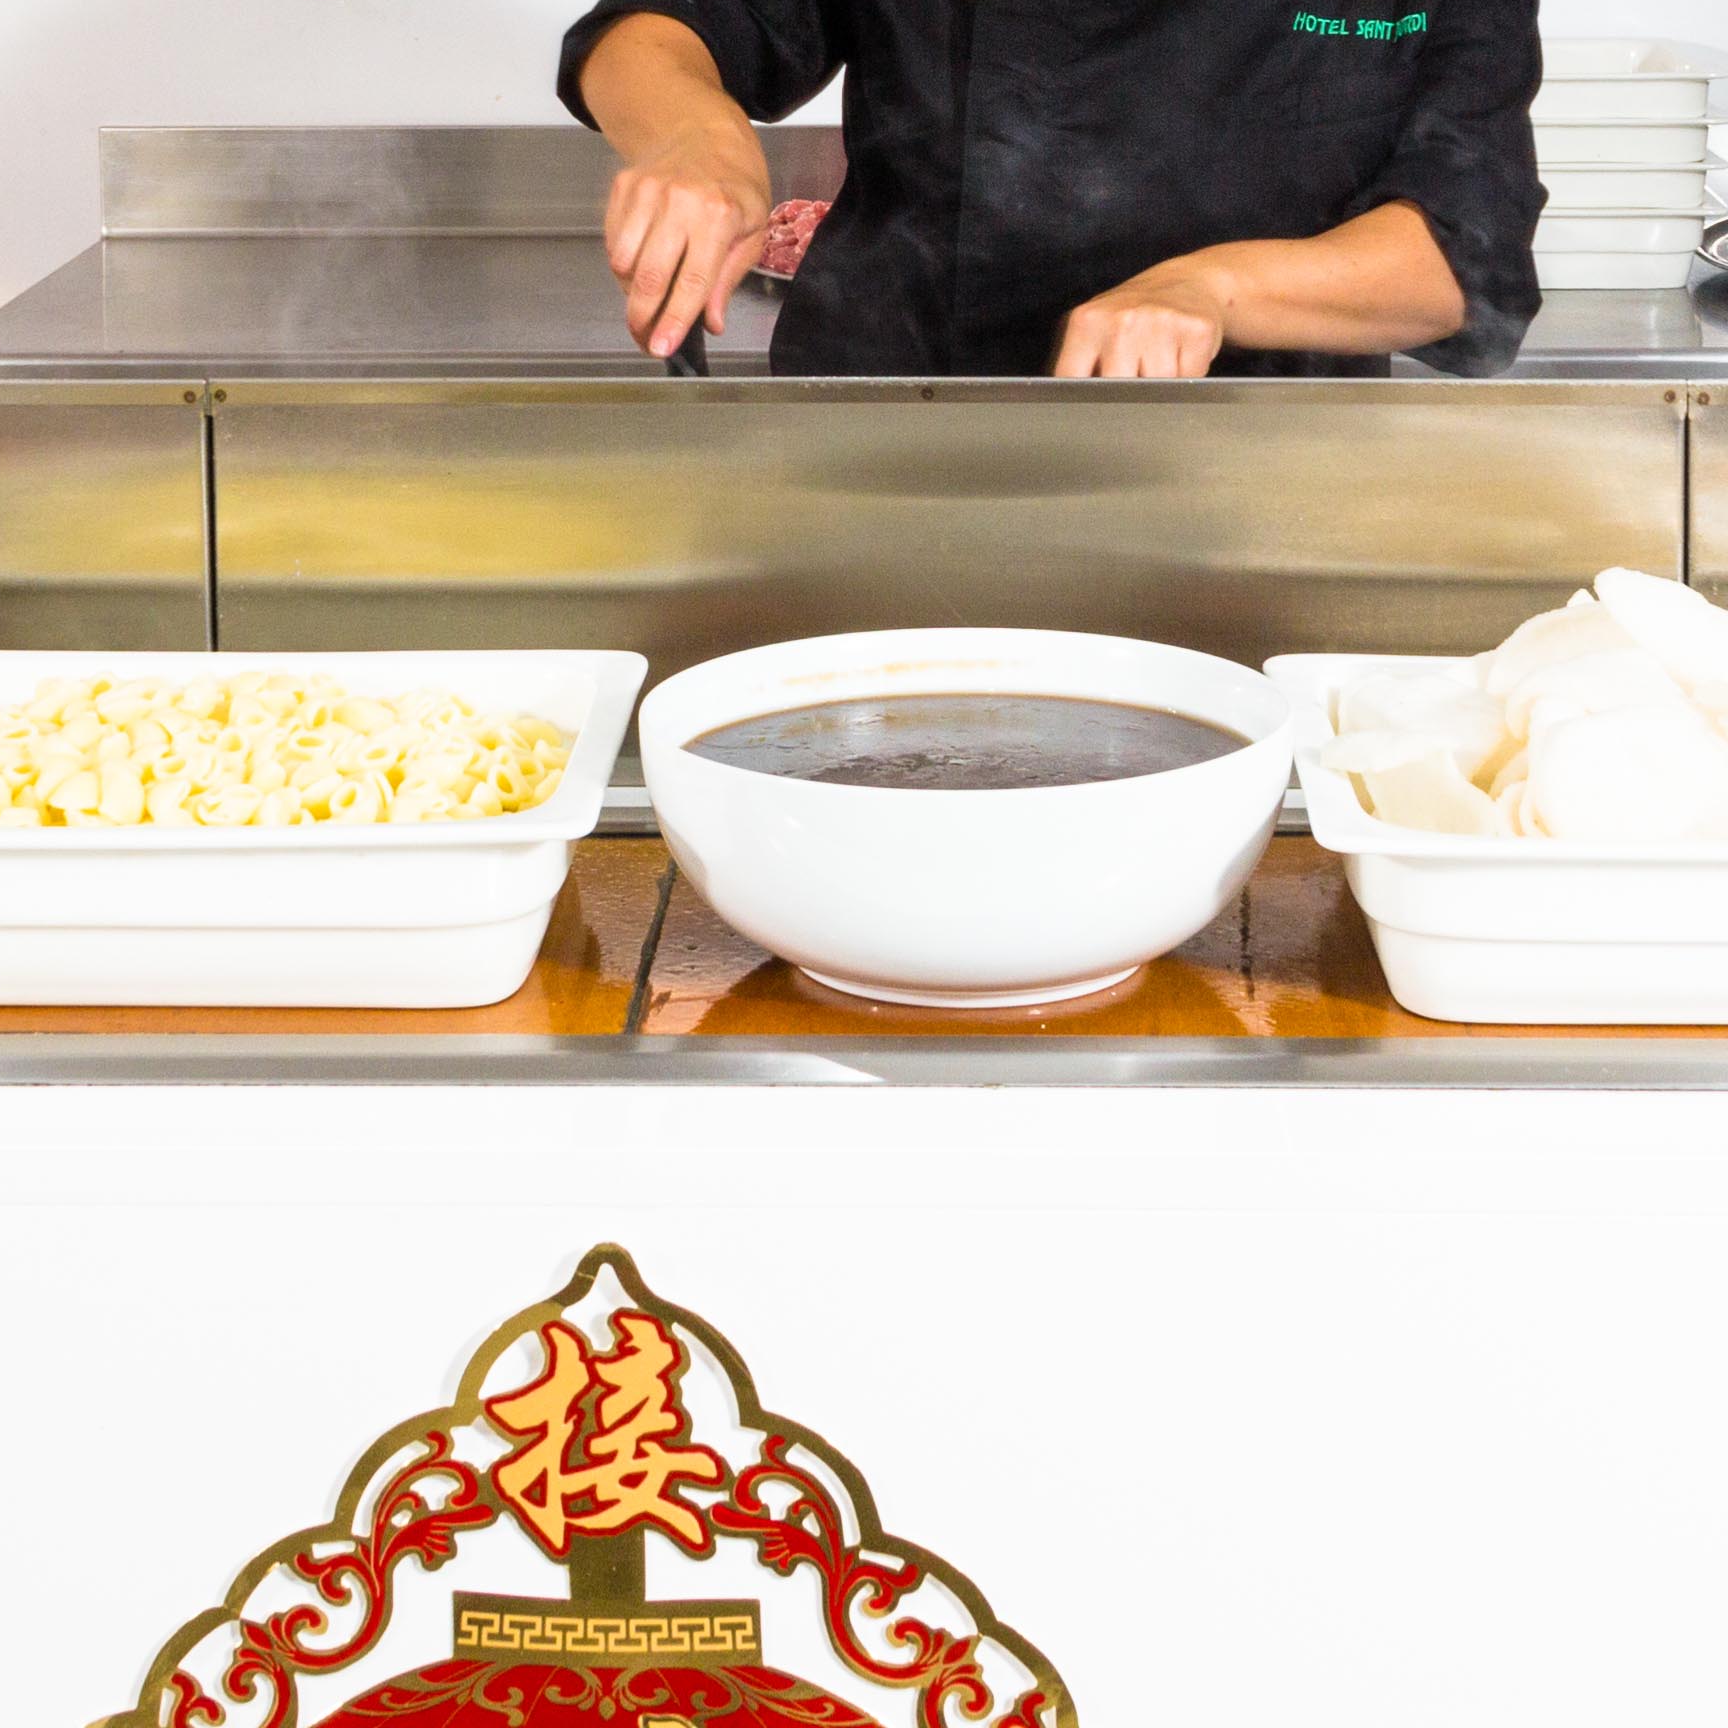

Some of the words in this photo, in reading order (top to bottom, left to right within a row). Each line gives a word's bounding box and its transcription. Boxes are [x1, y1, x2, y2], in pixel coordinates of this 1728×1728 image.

[1292, 11, 1350, 35] HOTEL
[1356, 19, 1394, 40] SANT
[486, 1308, 724, 1552] 接
